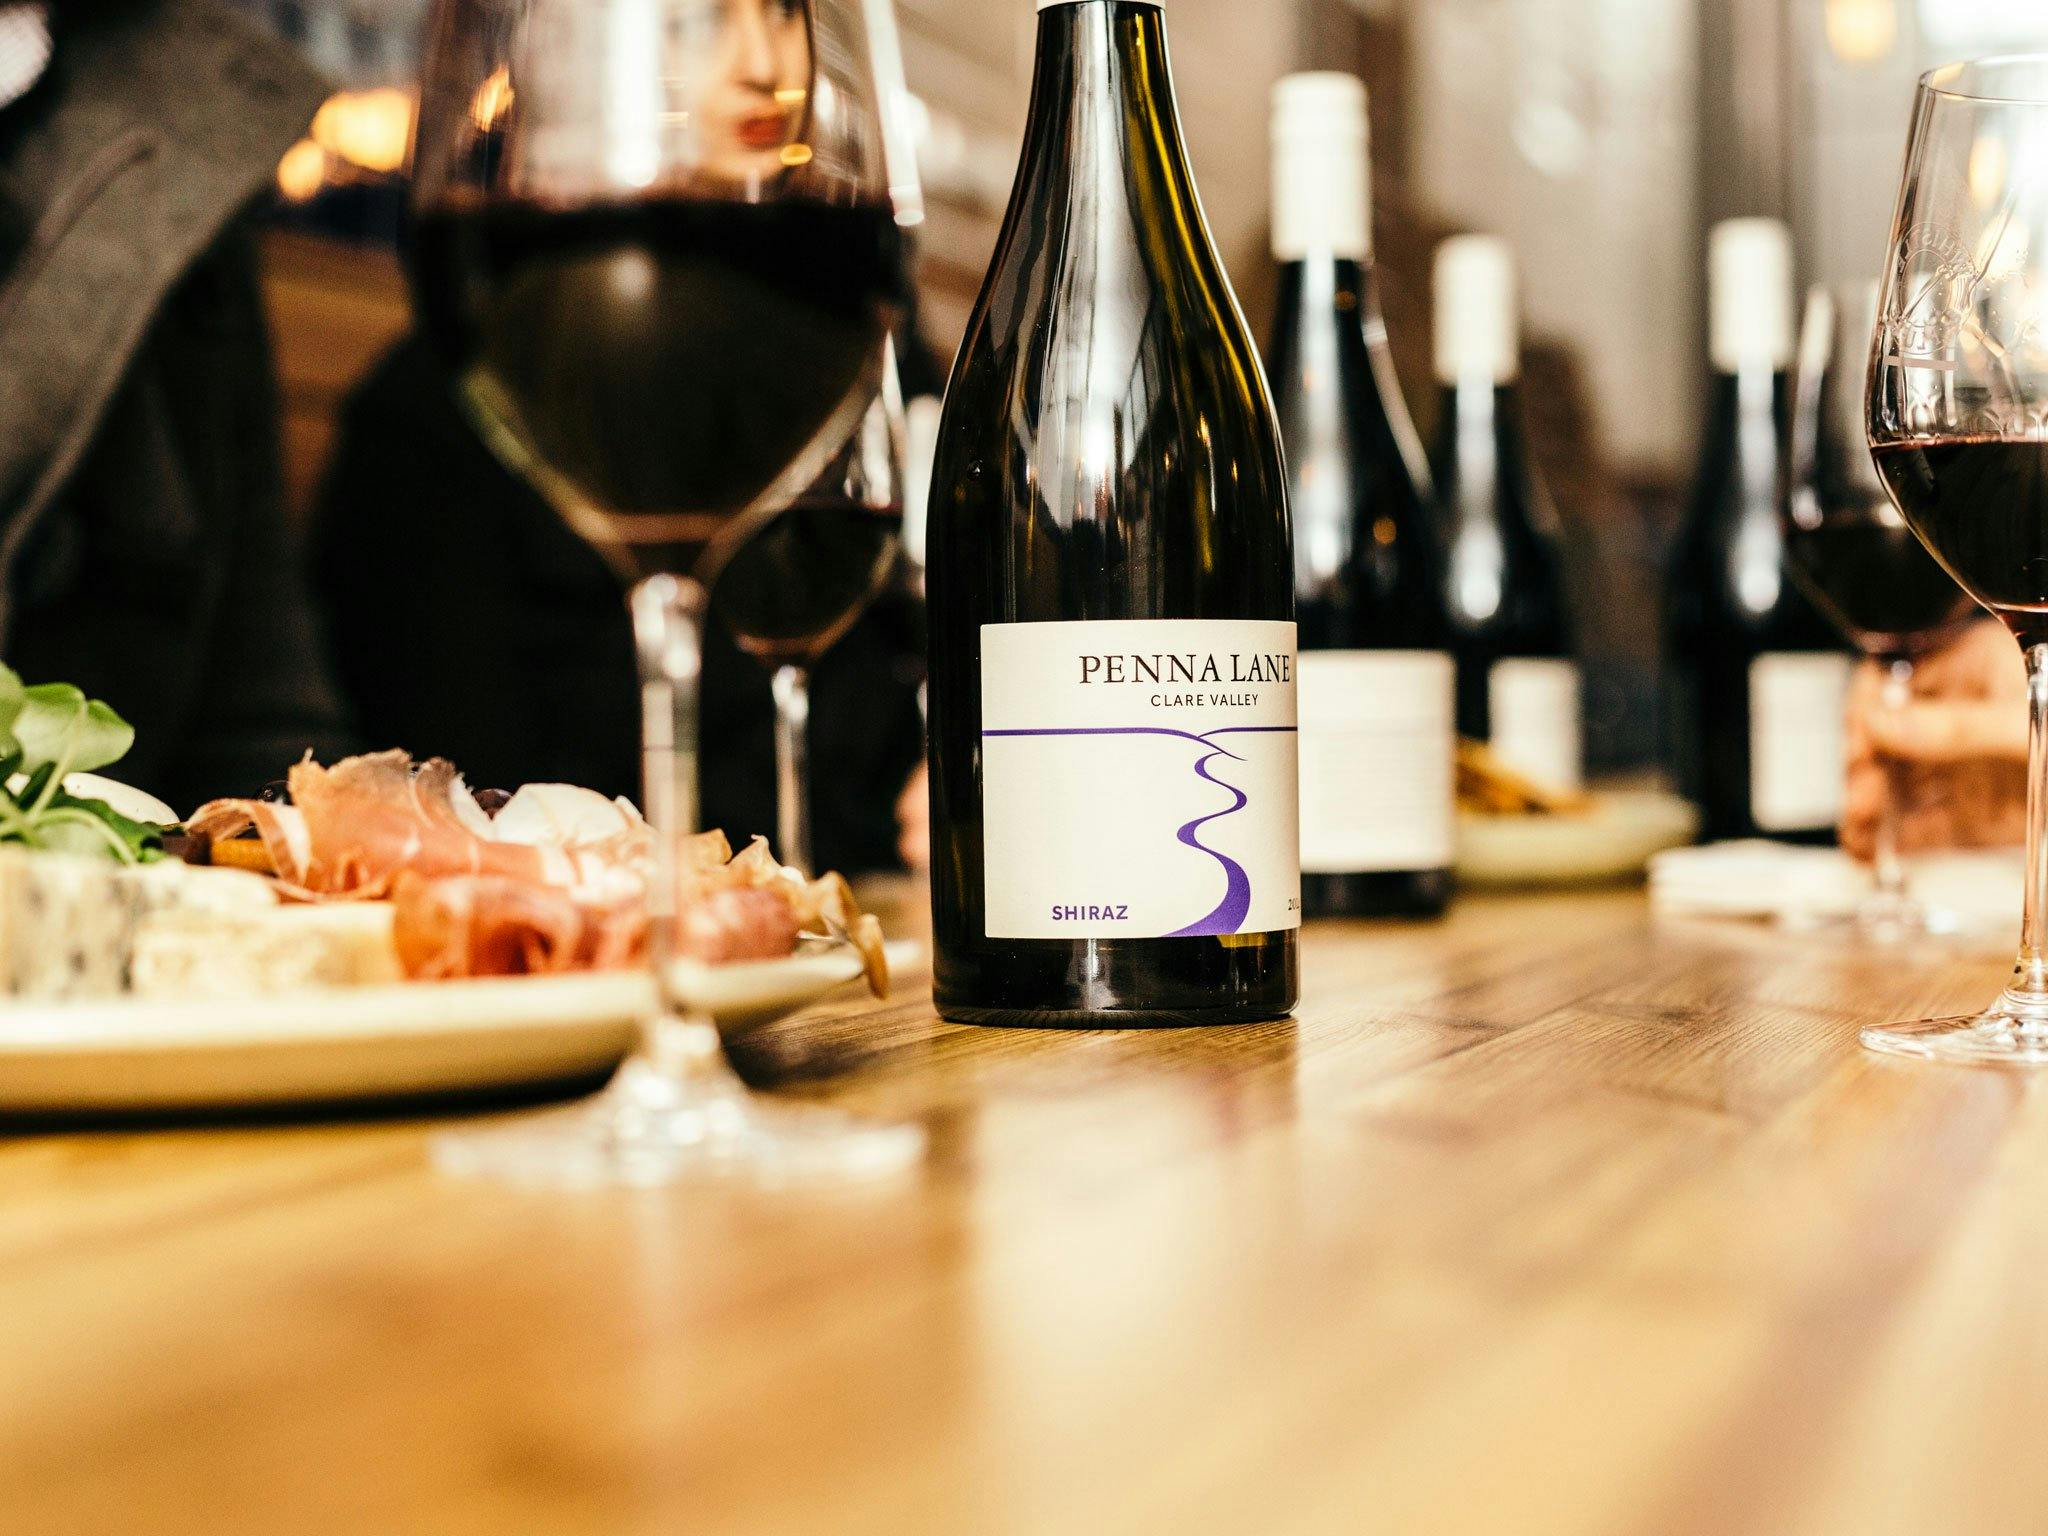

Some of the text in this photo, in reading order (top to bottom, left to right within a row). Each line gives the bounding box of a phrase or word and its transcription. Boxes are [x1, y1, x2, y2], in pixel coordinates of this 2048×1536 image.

[1078, 653, 1290, 684] PENNA LANE
[1150, 693, 1260, 708] CLARE VALLEY
[1051, 905, 1129, 921] SHIRAZ
